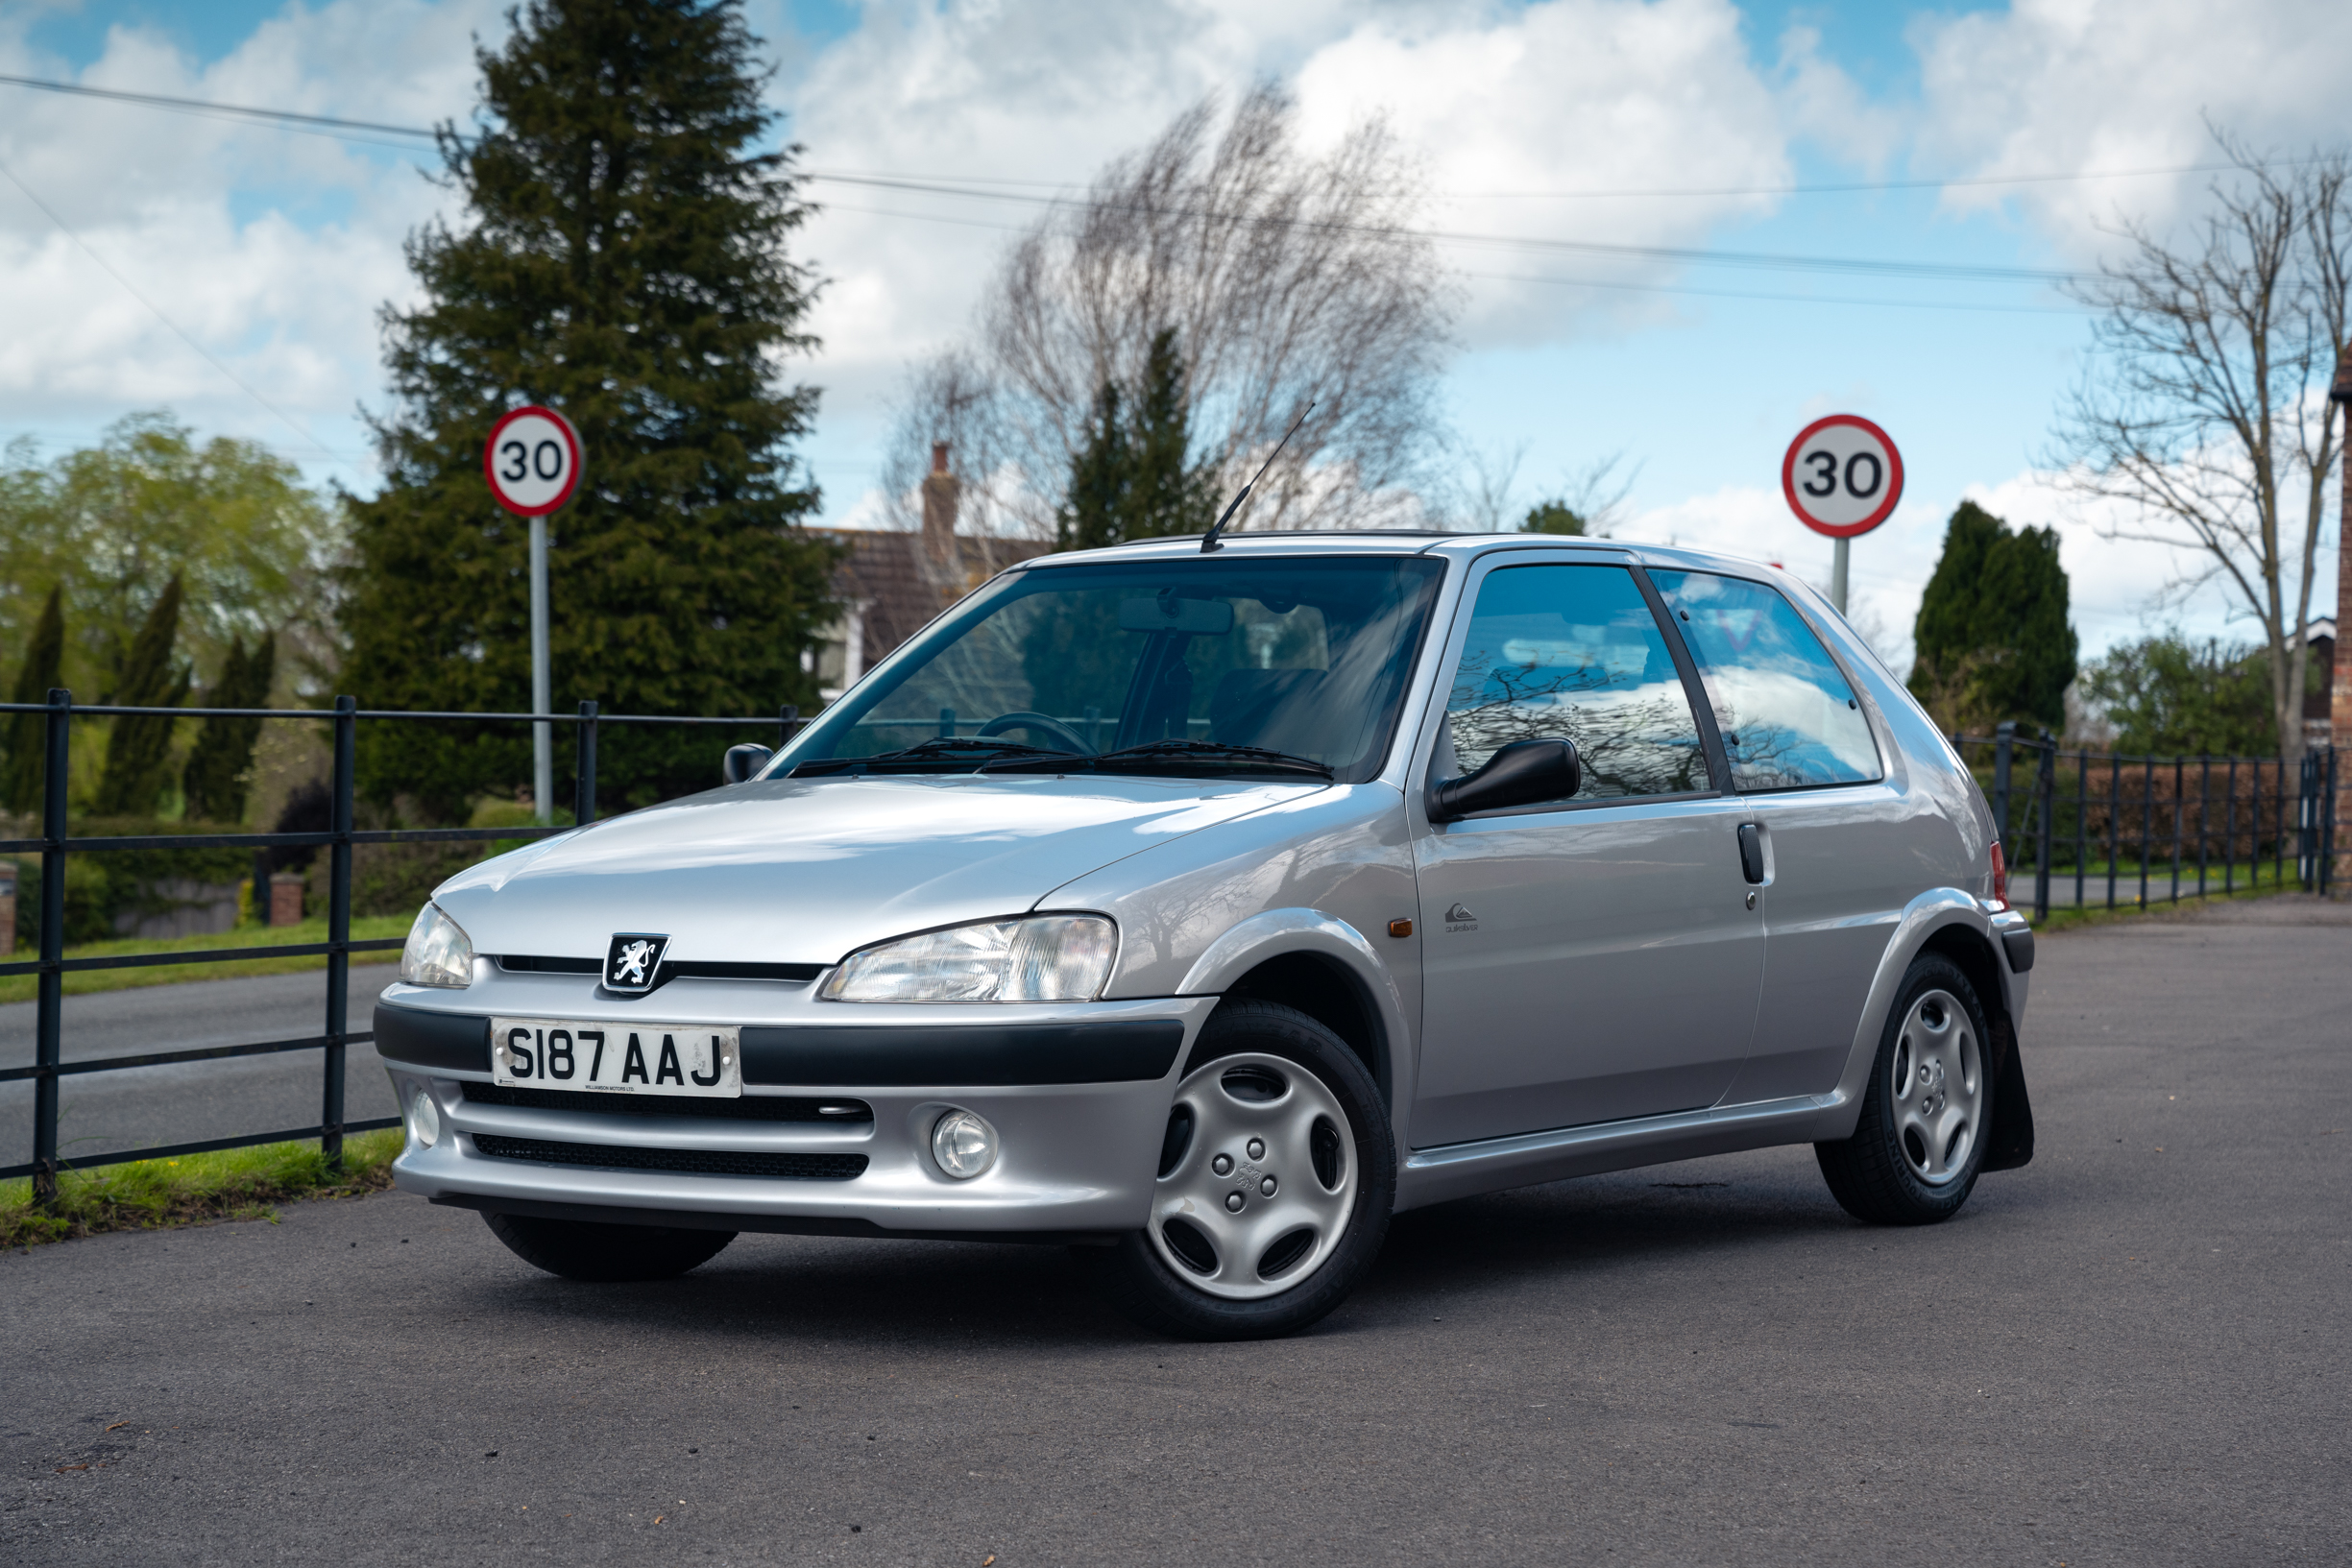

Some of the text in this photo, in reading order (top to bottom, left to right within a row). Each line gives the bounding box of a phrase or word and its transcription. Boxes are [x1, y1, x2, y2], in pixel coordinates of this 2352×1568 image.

[501, 440, 562, 481] 30
[1804, 450, 1881, 498] 30
[508, 1027, 721, 1087] S187 AAJ
[1887, 1130, 1923, 1203] TOURING
[1928, 1188, 1966, 1209] EAGLE
[1282, 1255, 1358, 1321] EAGLE
